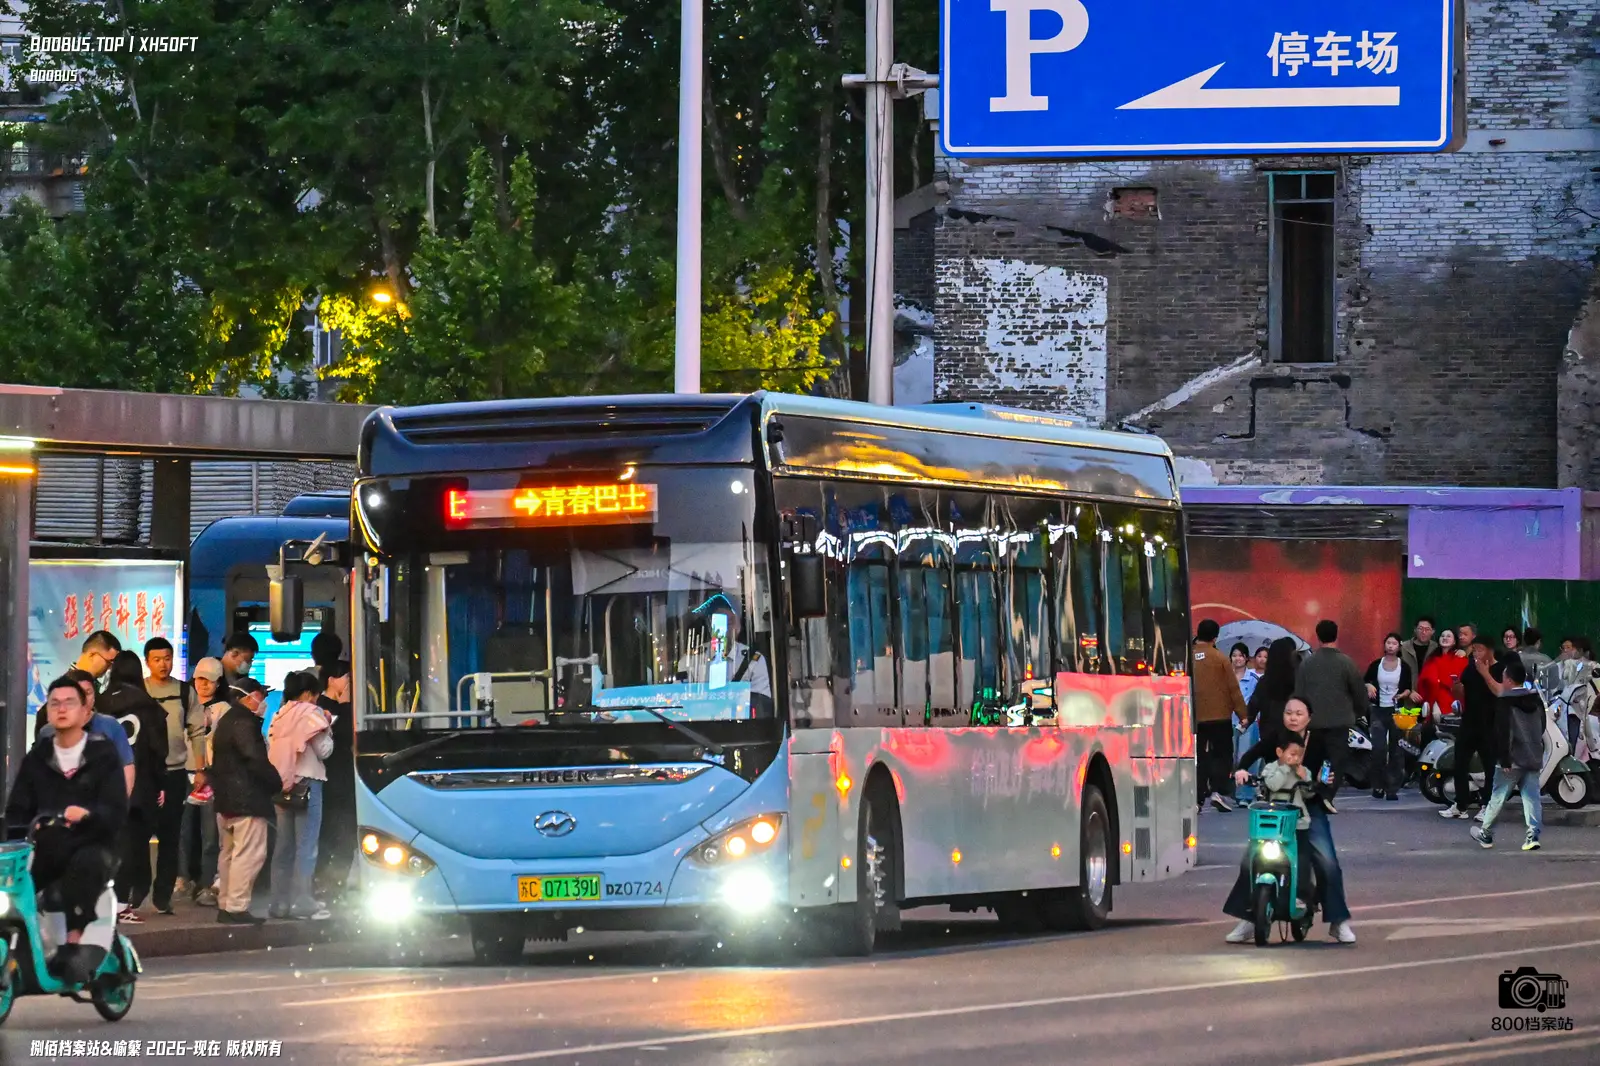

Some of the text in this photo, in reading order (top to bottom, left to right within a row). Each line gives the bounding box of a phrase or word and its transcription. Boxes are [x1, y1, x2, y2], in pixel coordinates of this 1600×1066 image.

[989, 0, 1090, 112] P
[1267, 31, 1399, 77] 停车场
[541, 484, 647, 516] 青春巴士
[522, 770, 590, 783] HIGER
[606, 881, 663, 897] DZ0724
